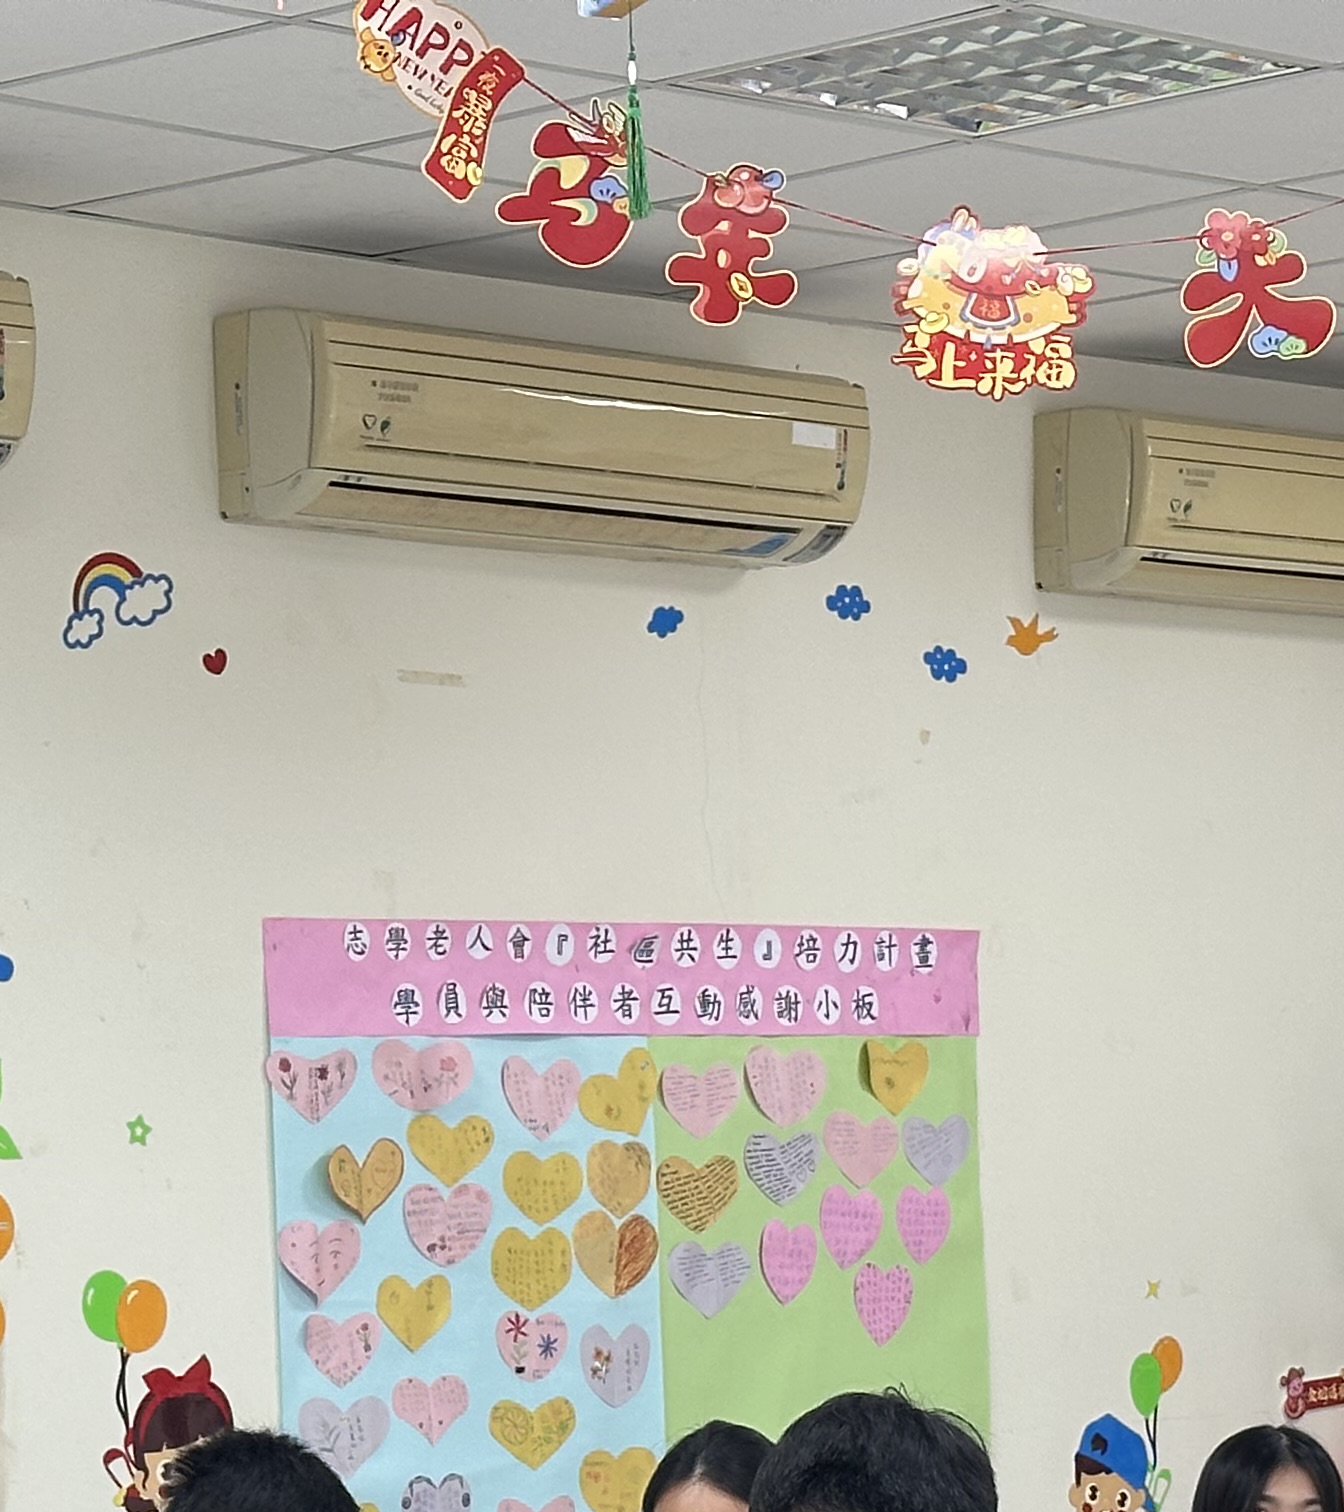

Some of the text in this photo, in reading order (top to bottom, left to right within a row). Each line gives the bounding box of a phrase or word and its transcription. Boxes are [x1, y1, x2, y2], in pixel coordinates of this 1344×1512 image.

[360, 0, 486, 76] HAPP
[440, 64, 507, 180] 一夜暴富
[1182, 210, 1337, 367] 大
[393, 982, 878, 1025] 學員與陪伴者互動感謝小板
